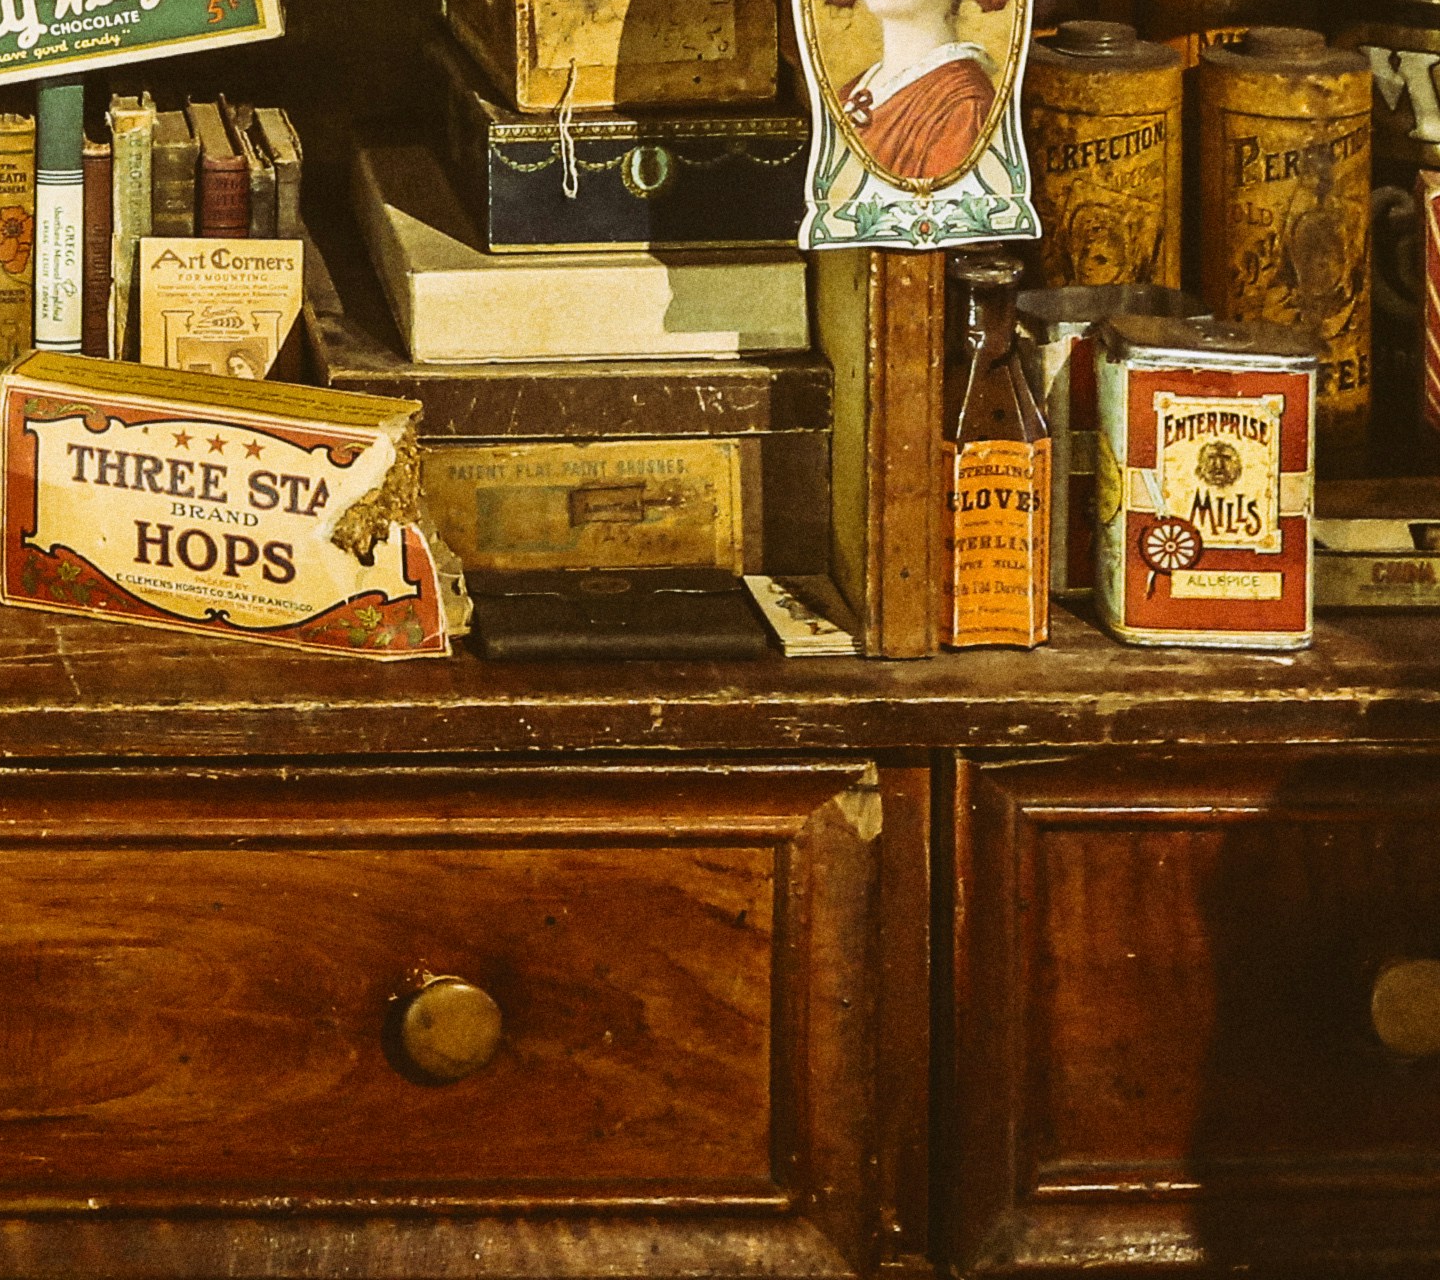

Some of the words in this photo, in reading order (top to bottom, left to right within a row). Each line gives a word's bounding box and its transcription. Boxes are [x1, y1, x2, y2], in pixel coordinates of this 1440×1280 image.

[50, 10, 141, 35] CHOCOLATE
[34, 42, 69, 59] good
[151, 248, 206, 270] Art
[211, 248, 295, 271] Corners
[204, 274, 268, 282] MOUNTING
[1163, 409, 1272, 448] ENTERPRISE
[66, 439, 230, 503] THREE
[248, 471, 330, 518] STA
[169, 501, 261, 527] BRAND
[1189, 493, 1262, 538] MILLS
[133, 520, 299, 586] HOPS
[1186, 574, 1261, 589] ALLSPICE
